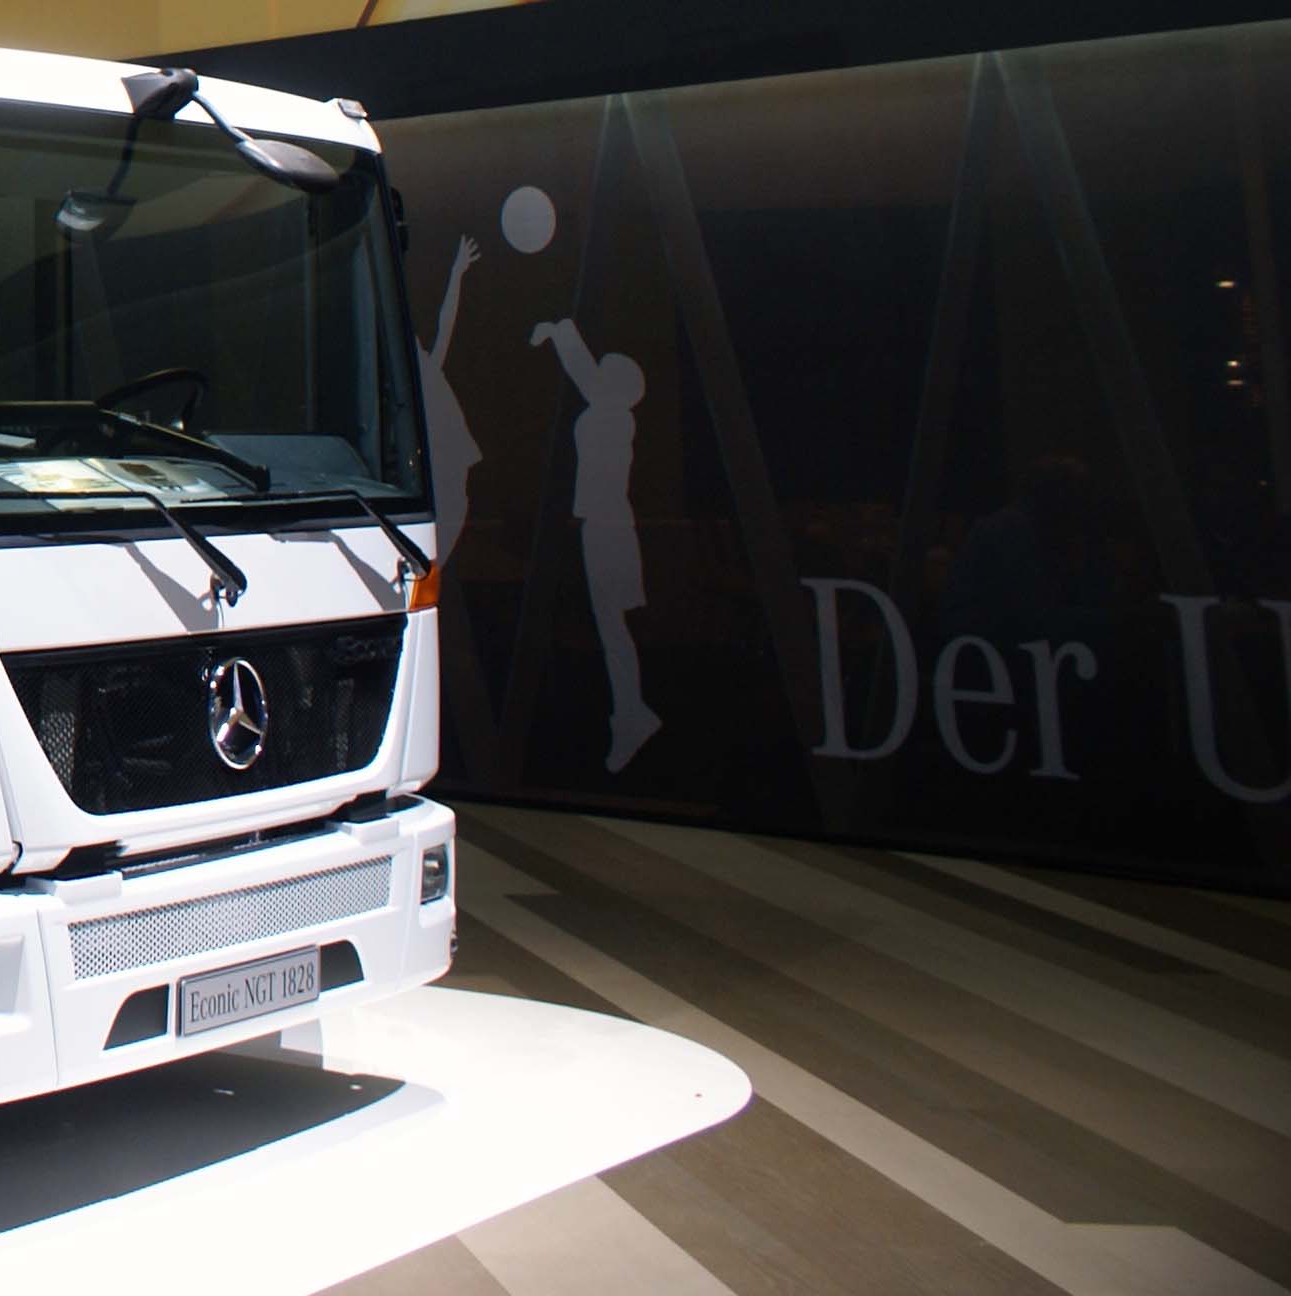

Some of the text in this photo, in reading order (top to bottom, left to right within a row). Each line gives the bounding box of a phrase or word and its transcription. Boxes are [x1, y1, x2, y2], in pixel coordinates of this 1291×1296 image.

[800, 576, 1099, 781] Der
[189, 961, 315, 1023] Econic NGT 1828
